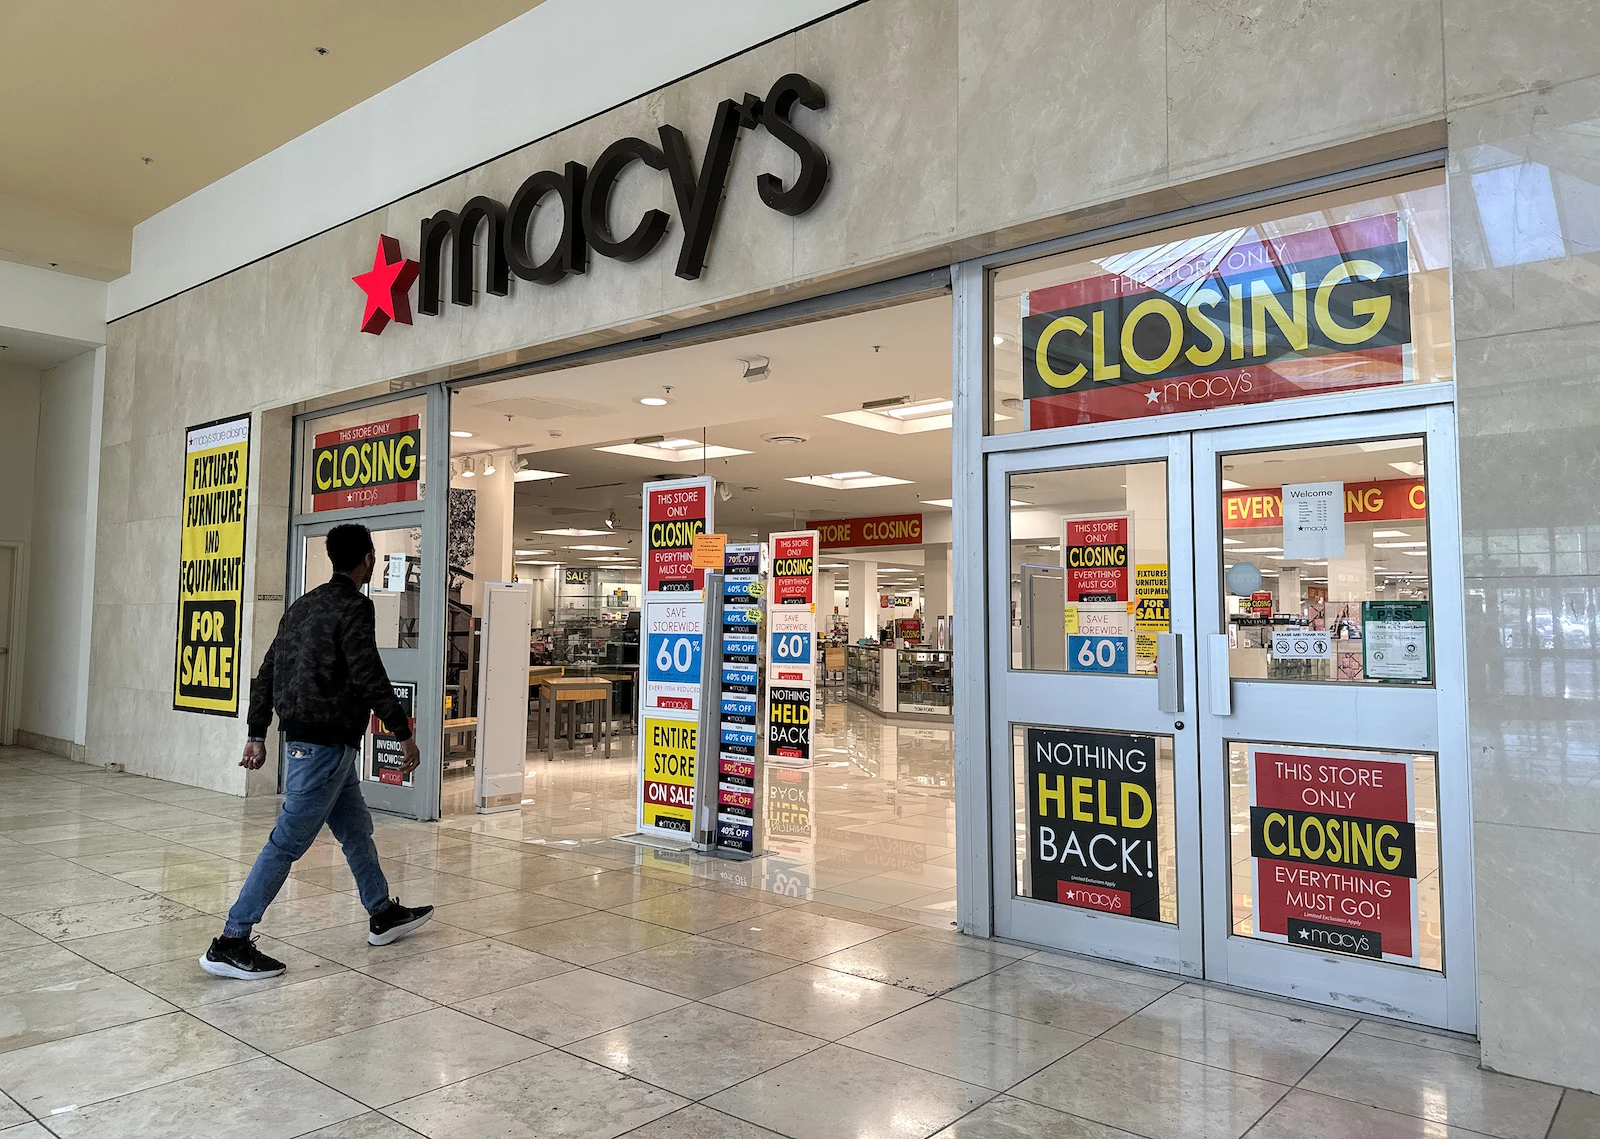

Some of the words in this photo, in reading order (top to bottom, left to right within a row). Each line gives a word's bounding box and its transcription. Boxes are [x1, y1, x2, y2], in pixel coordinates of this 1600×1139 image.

[1111, 274, 1152, 295] THIS
[1155, 258, 1220, 287] STORE
[1227, 242, 1287, 272] ONLY
[1035, 259, 1392, 390] CLOSING
[1164, 368, 1253, 403] macy's
[212, 430, 226, 442] store
[226, 426, 248, 439] closing
[339, 430, 351, 441] THIS
[352, 426, 372, 439] STORE
[373, 423, 390, 435] ONLY
[193, 449, 239, 490] FIXTURES
[315, 434, 417, 491] CLOSING
[352, 488, 378, 504] macy's
[658, 493, 673, 505] THIS
[674, 491, 698, 503] STORE
[1290, 489, 1333, 498] Welcome
[187, 488, 242, 528] FURNITURE
[666, 506, 688, 517] ONLY
[863, 519, 920, 540] CLOSING
[1075, 524, 1091, 533] THIS
[1092, 522, 1119, 532] STORE
[1304, 524, 1328, 532] macy's
[205, 530, 220, 554] AND
[1085, 533, 1108, 543] ONLY
[655, 552, 692, 562] EVERYTHIN
[1069, 546, 1125, 568] CLOSING
[182, 556, 241, 596] EQUIPMENT
[659, 564, 678, 575] MUST
[776, 558, 812, 576] CLOSING
[1074, 569, 1122, 580] EVERYTHING
[1078, 580, 1098, 589] MUST
[1099, 579, 1117, 589] GO!
[666, 608, 686, 618] SAVE
[1144, 600, 1164, 608] FOR
[1086, 615, 1109, 624] SAVE
[1378, 610, 1412, 620] PASS
[191, 611, 224, 643] FOR
[653, 622, 700, 632] STOREWIDE
[1078, 626, 1123, 635] TOREWIDE
[656, 637, 700, 673] 60%
[778, 635, 808, 658] 60%
[1077, 639, 1125, 668] 60%
[181, 646, 232, 689] SALE
[726, 673, 740, 681] 60%
[393, 688, 408, 698] TORE
[772, 690, 810, 702] NOTHING
[724, 703, 737, 711] 60%
[771, 703, 810, 724] HELD
[654, 726, 696, 750] ENTIRE
[725, 733, 739, 741] 60%
[740, 734, 753, 743] OFF
[771, 726, 810, 744] BACK!
[376, 739, 402, 751] INVENTO
[654, 752, 694, 778] STORE
[1036, 741, 1148, 774] NOTHING
[724, 764, 737, 772] 50%
[738, 766, 751, 775] OFF
[1275, 762, 1312, 782] THIS
[1318, 765, 1383, 788] STORE
[648, 782, 668, 802] ON
[670, 785, 694, 806] SALE
[723, 794, 737, 803] 50%
[738, 796, 751, 805] OFF
[1038, 773, 1153, 830] HELD
[1302, 788, 1356, 810] ONLY
[721, 827, 735, 836] 40%
[736, 828, 749, 838] OFF
[1263, 812, 1402, 871] CLOSING
[1039, 826, 1154, 878] BACK!
[1071, 875, 1086, 883] Limited
[1086, 877, 1105, 886] Exclusions
[1275, 866, 1392, 899] EVERYTHING
[1076, 888, 1122, 910] macy's
[1286, 891, 1335, 912] MUST
[1341, 898, 1381, 920] GO!
[1304, 912, 1322, 920] Limited
[1322, 914, 1346, 924] Exclusions
[1347, 918, 1361, 926] Apply
[1311, 928, 1370, 952] macy's
